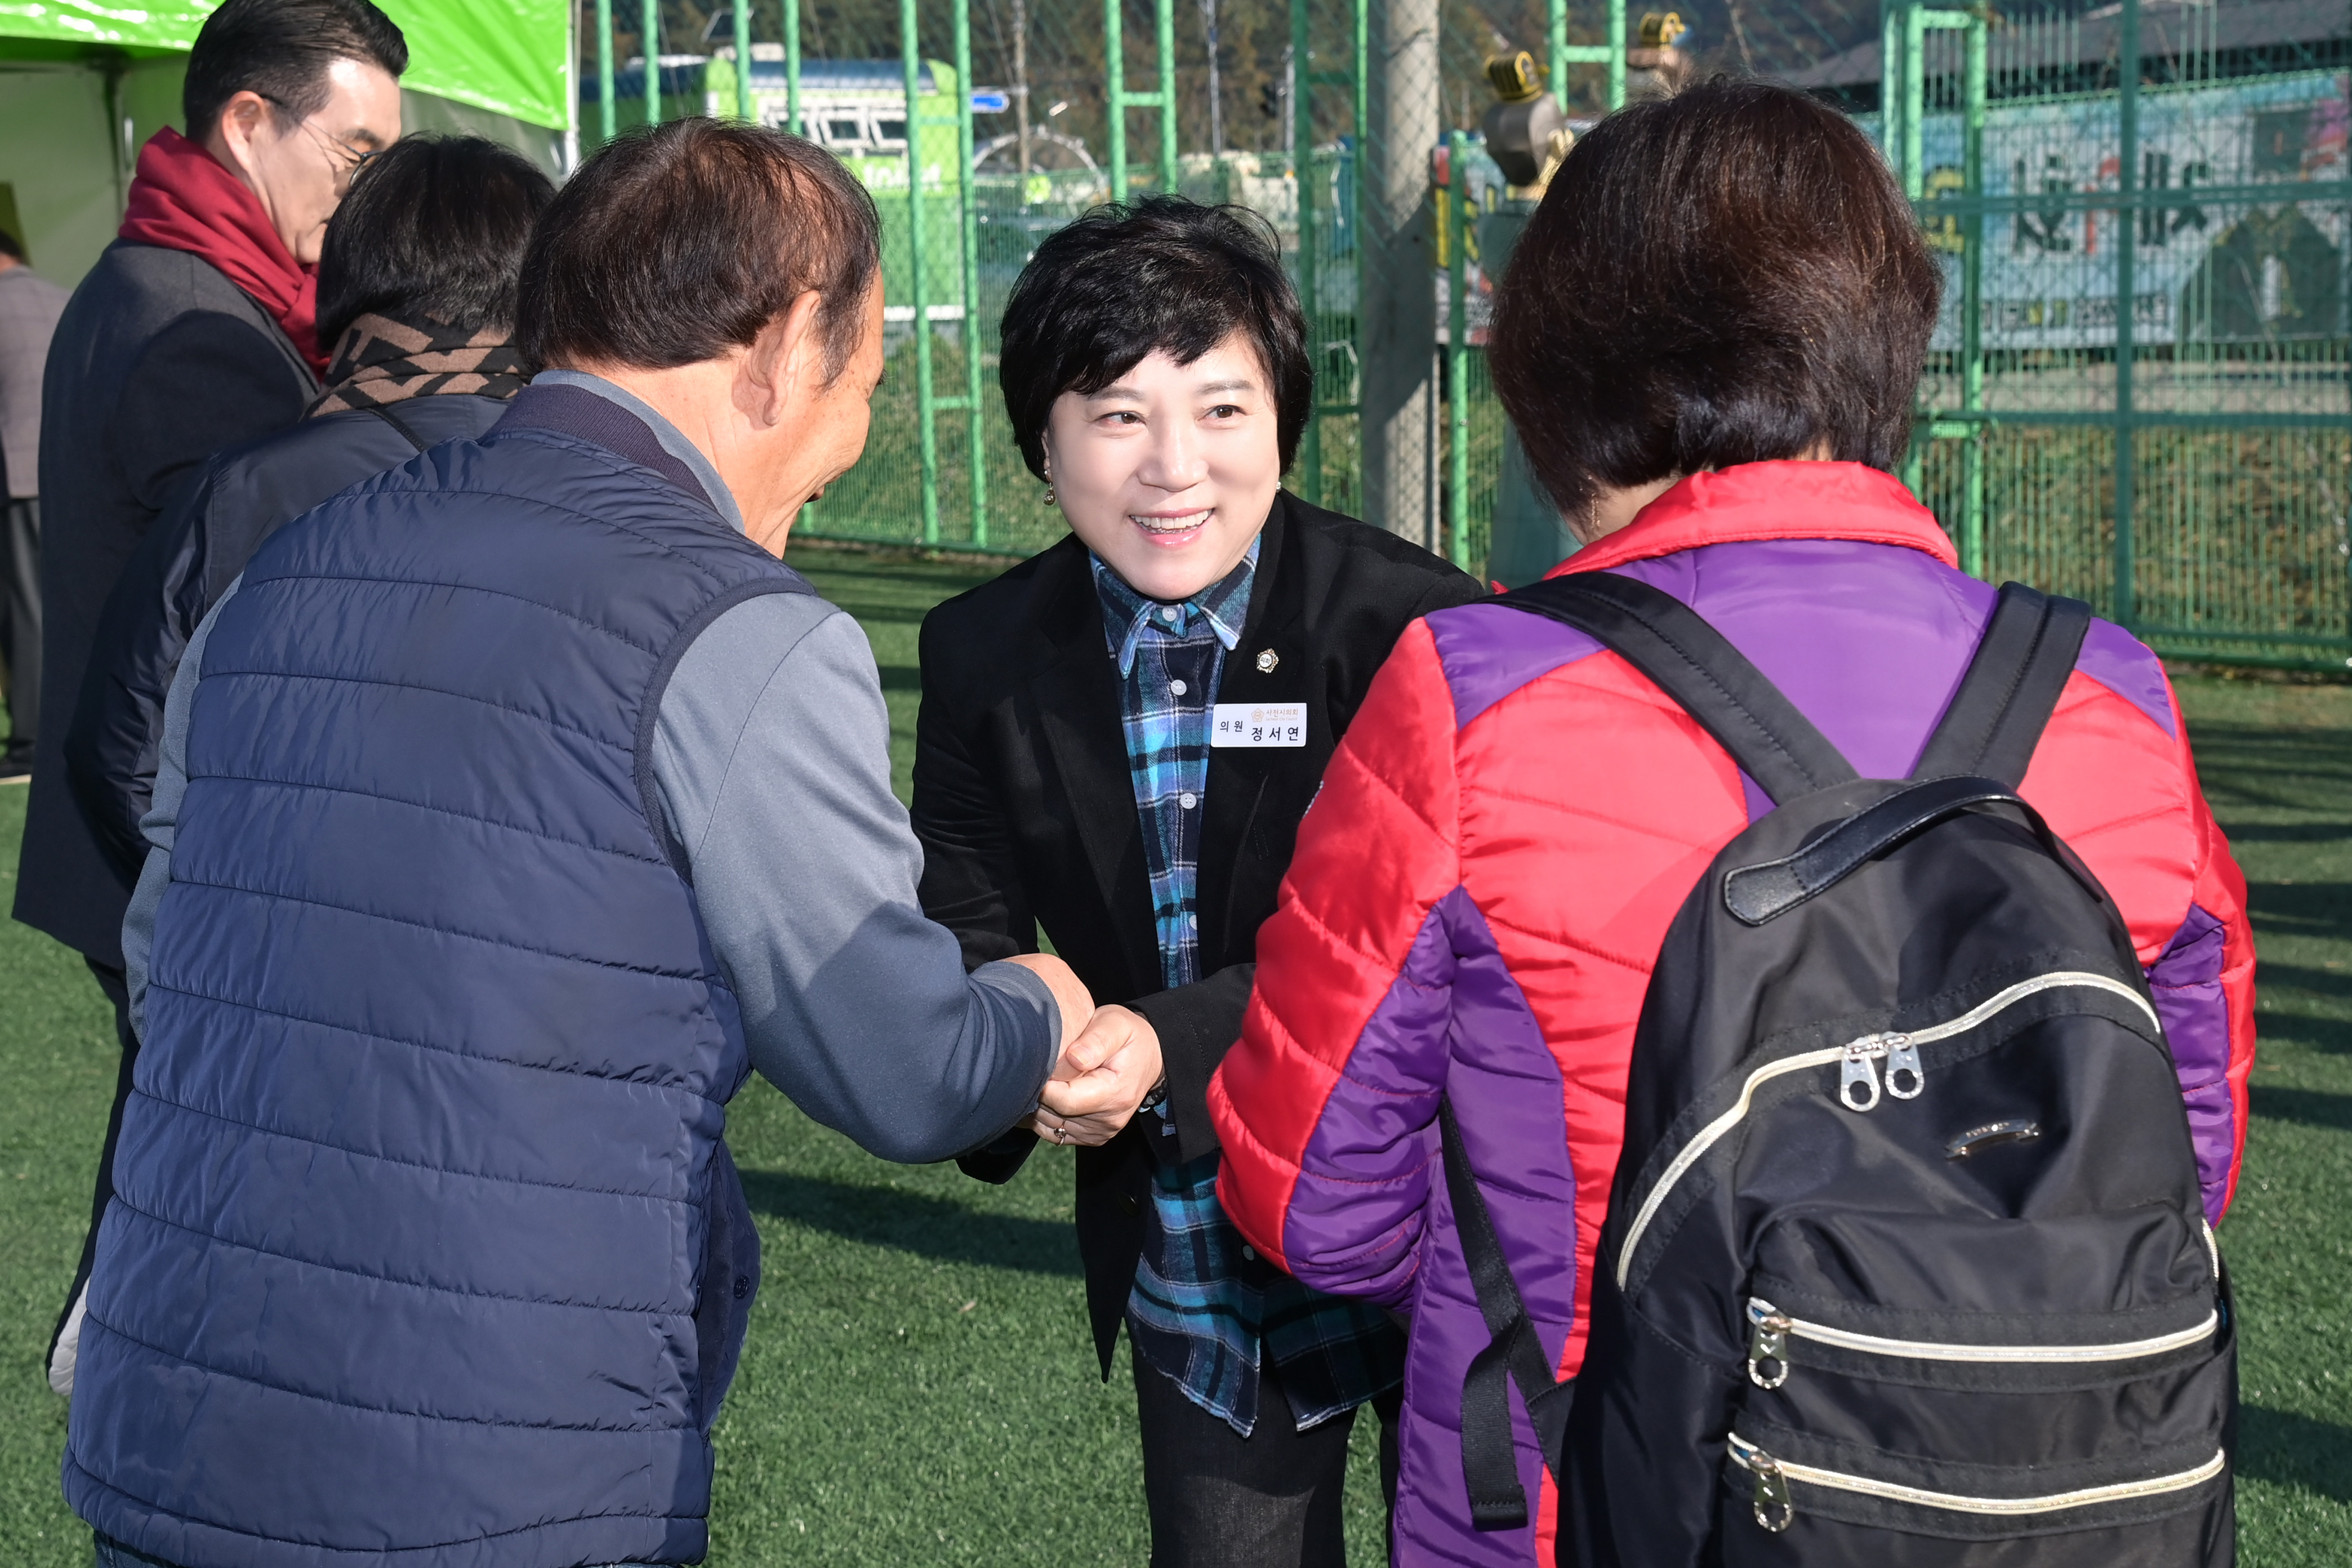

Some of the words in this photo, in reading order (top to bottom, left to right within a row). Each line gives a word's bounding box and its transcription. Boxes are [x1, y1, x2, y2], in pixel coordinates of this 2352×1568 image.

[1266, 709, 1298, 717] 사천시의회
[1220, 720, 1243, 732] 의원
[1251, 727, 1298, 742] 정서연
